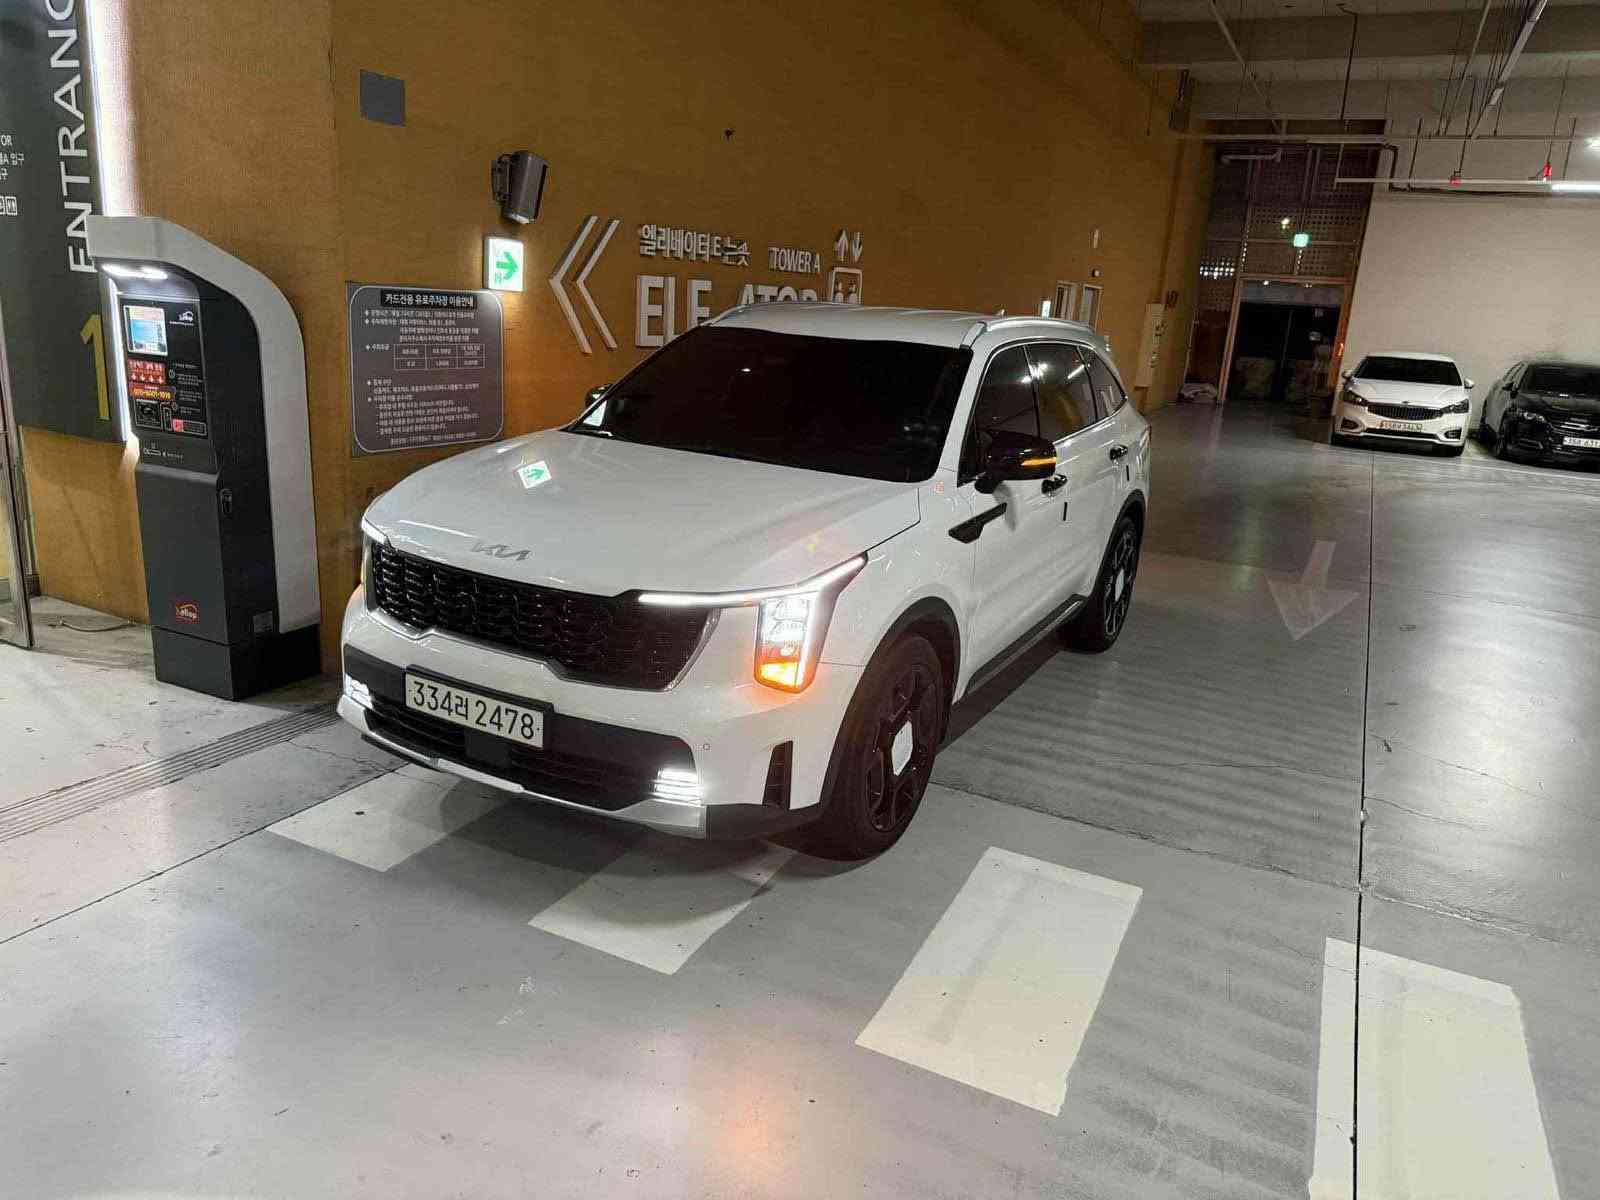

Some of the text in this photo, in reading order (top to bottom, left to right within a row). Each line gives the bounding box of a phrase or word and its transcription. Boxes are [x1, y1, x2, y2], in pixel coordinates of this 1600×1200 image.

[639, 224, 710, 263] 엘리베이터
[768, 247, 821, 273] TOWER A
[80, 314, 110, 420] 1
[475, 700, 534, 740] 2478
